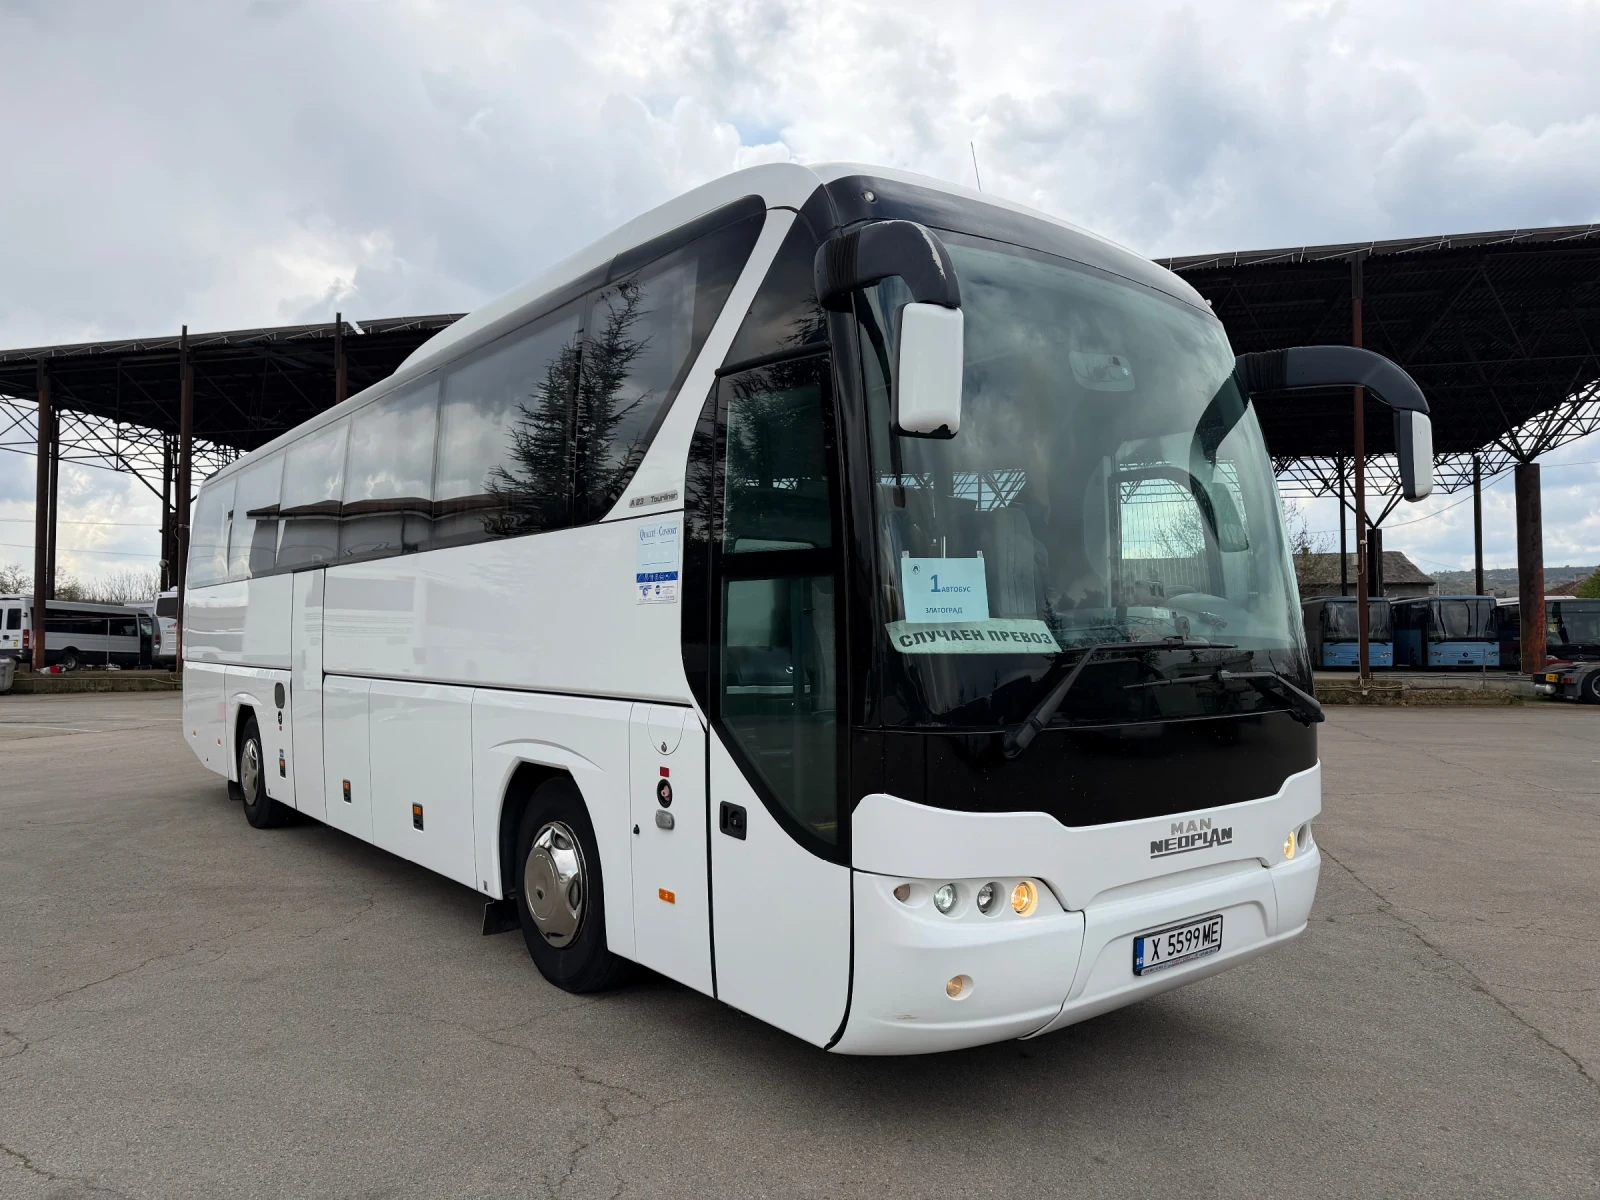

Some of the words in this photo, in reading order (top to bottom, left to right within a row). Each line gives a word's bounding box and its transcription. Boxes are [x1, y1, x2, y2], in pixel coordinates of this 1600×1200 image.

[930, 574, 941, 593] 1
[899, 629, 985, 648] СЛУЧАЕН
[987, 629, 1053, 645] ПРЕВОЗ
[1170, 817, 1212, 836] MAN
[1150, 827, 1233, 857] NEOPLAN
[1151, 937, 1161, 962] X
[1167, 926, 1201, 957] 5599
[1202, 920, 1220, 946] ME
